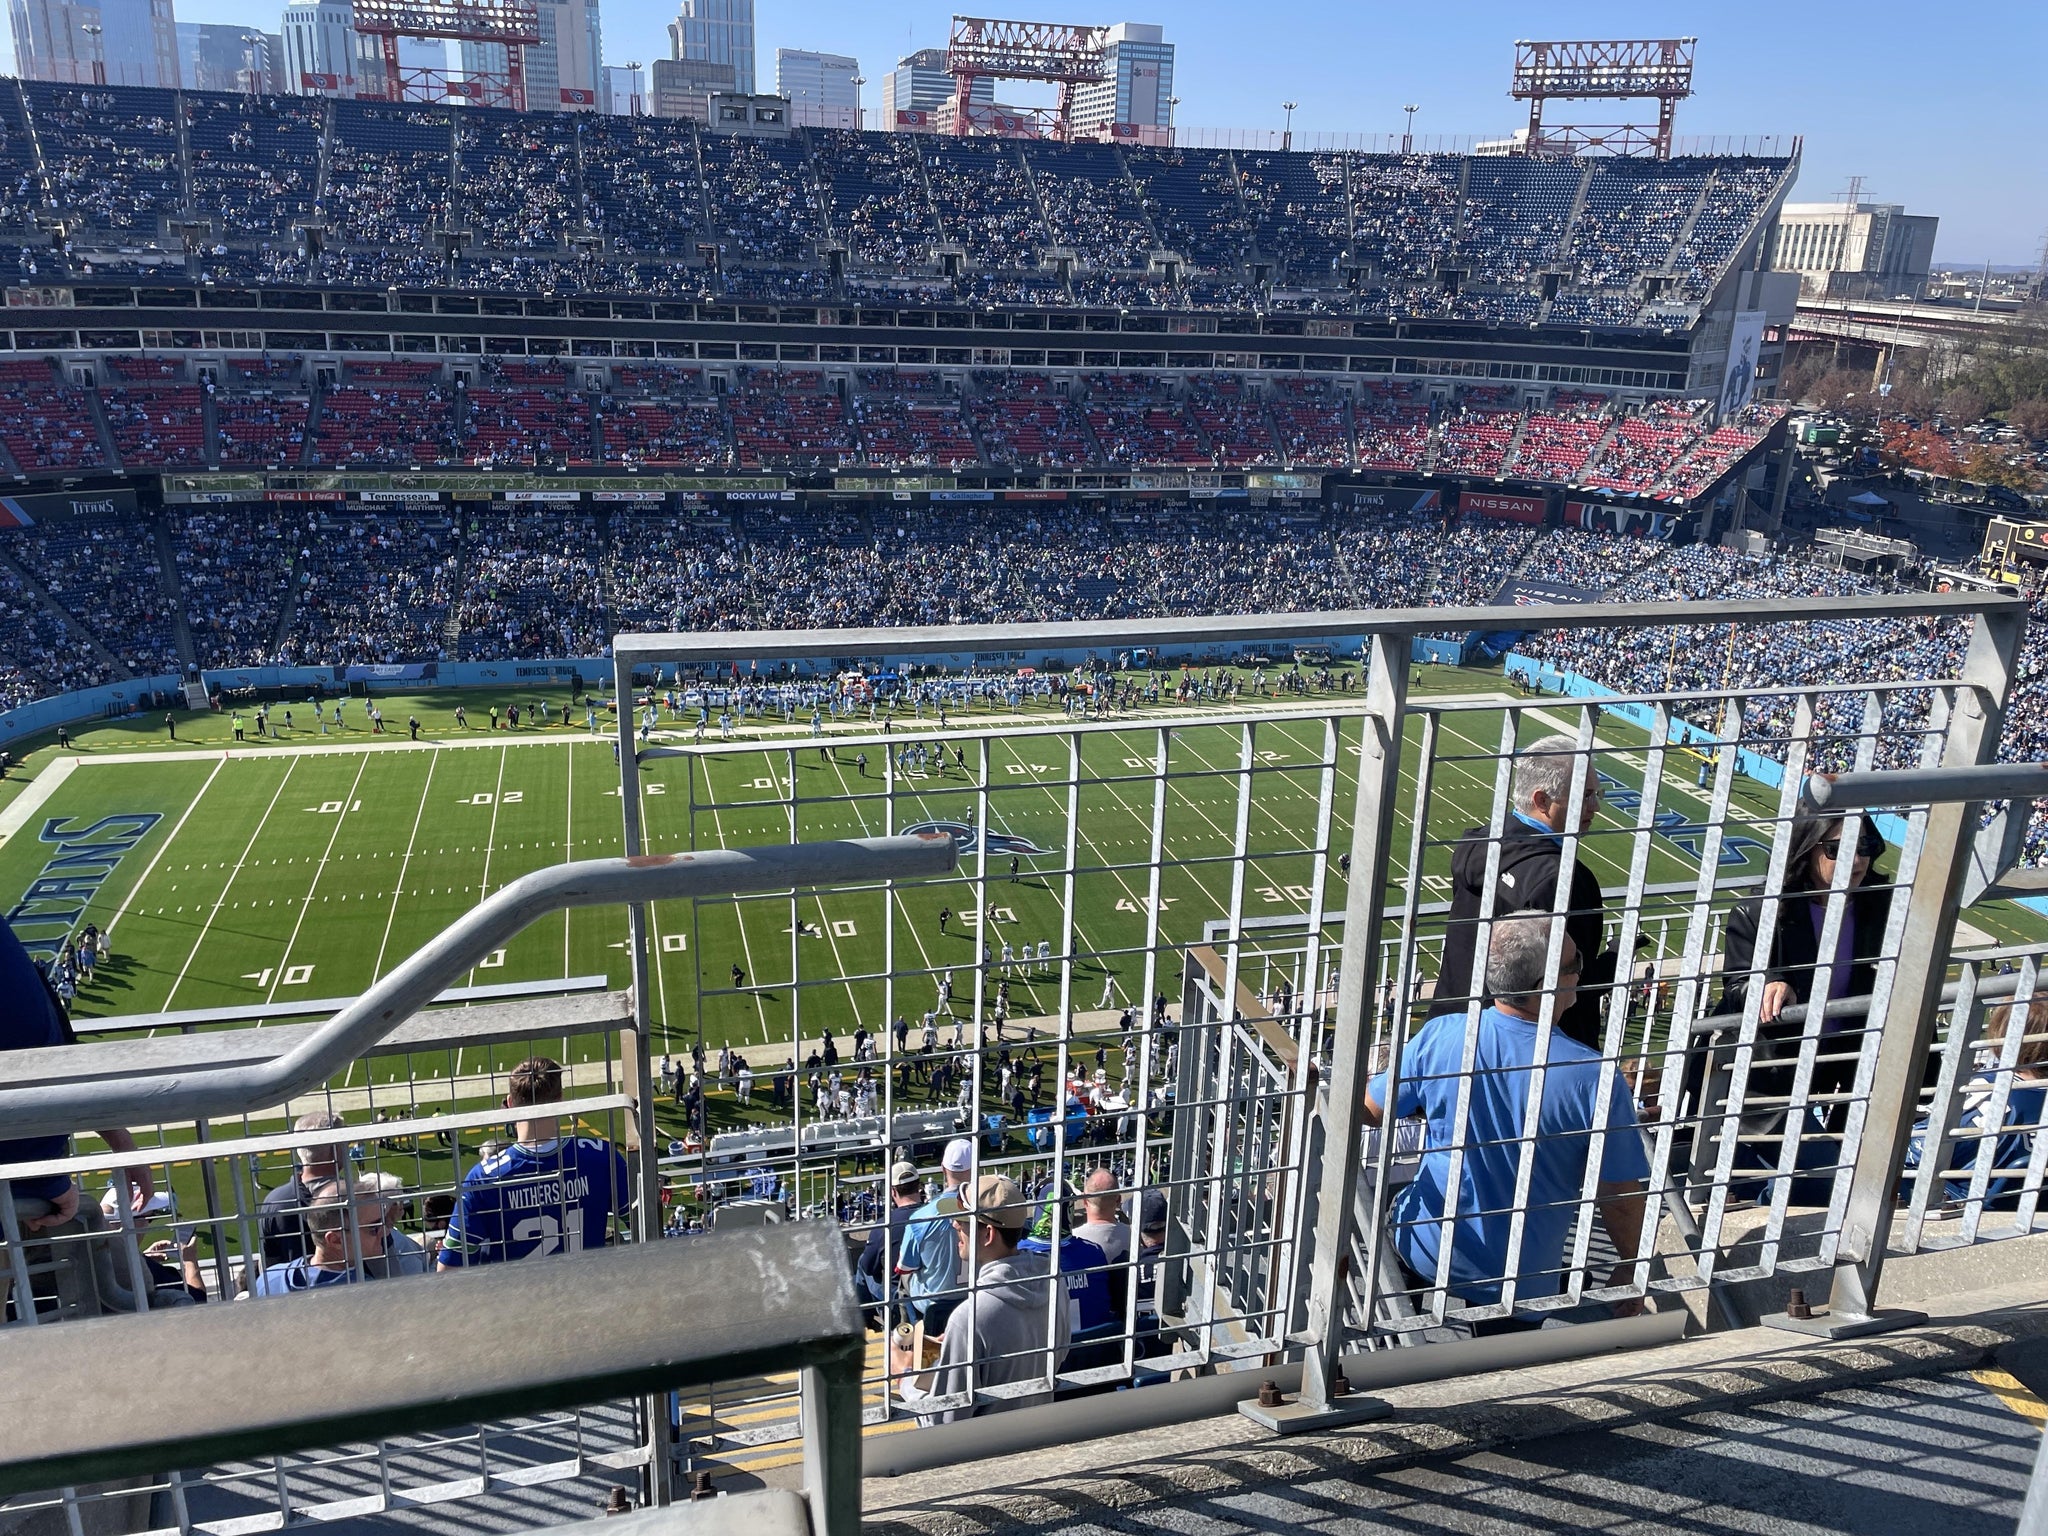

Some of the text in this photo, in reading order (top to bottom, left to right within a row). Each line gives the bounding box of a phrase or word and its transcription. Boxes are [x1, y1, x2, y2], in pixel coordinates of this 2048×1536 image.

[368, 492, 434, 501] Tennessean.
[683, 492, 706, 500] FedEx
[726, 492, 756, 500] ROCKY
[758, 492, 778, 500] LAW
[1470, 497, 1534, 512] NISSAN
[1515, 587, 1582, 602] NISSAN
[257, 964, 316, 988] 10
[507, 1175, 590, 1210] WITHERSPOON
[512, 1207, 584, 1262] 21
